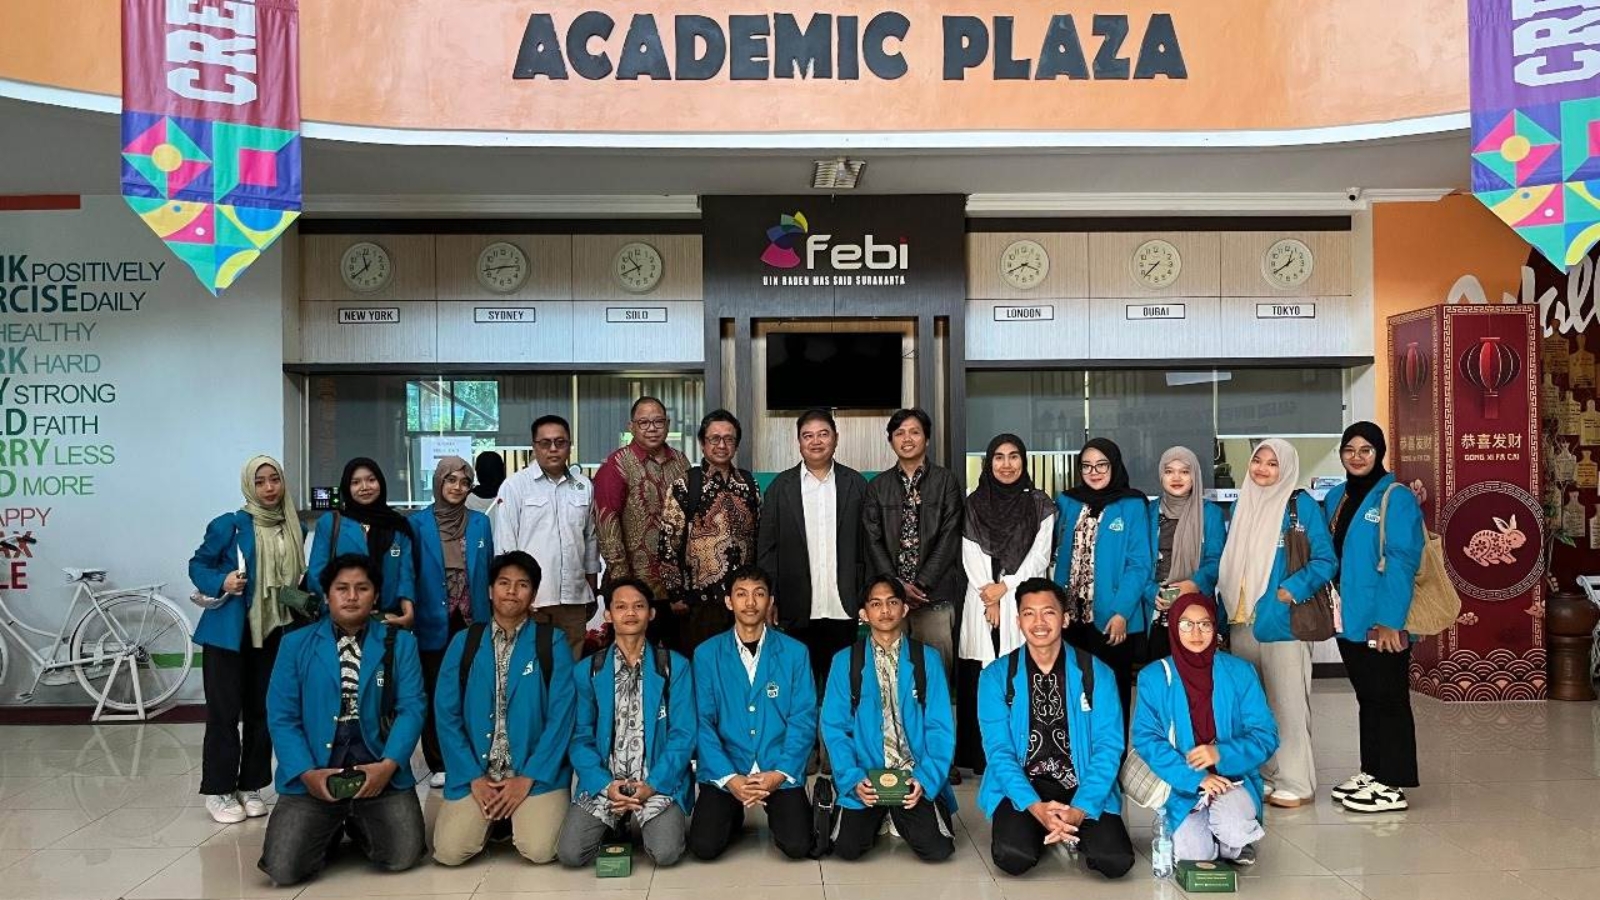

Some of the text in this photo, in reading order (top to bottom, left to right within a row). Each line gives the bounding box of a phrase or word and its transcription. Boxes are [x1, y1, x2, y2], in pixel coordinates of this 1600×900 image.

[512, 11, 1188, 81] ACADEMIC PLAZA
[806, 235, 908, 269] febi
[32, 262, 165, 282] POSITIVELY
[81, 292, 146, 311] DAILY
[1272, 305, 1301, 316] TOKYO
[344, 310, 394, 321] NEW YORK
[488, 310, 525, 320] SYDNEY
[625, 310, 649, 320] SOLO
[1006, 308, 1042, 318] LONDON
[1143, 306, 1170, 317] DUBAI
[34, 353, 101, 374] HARD
[14, 384, 116, 404] STRONG
[33, 416, 98, 435] FAITH
[1460, 433, 1523, 449] 恭喜发财
[55, 445, 115, 465] LESS
[23, 475, 95, 496] MORE
